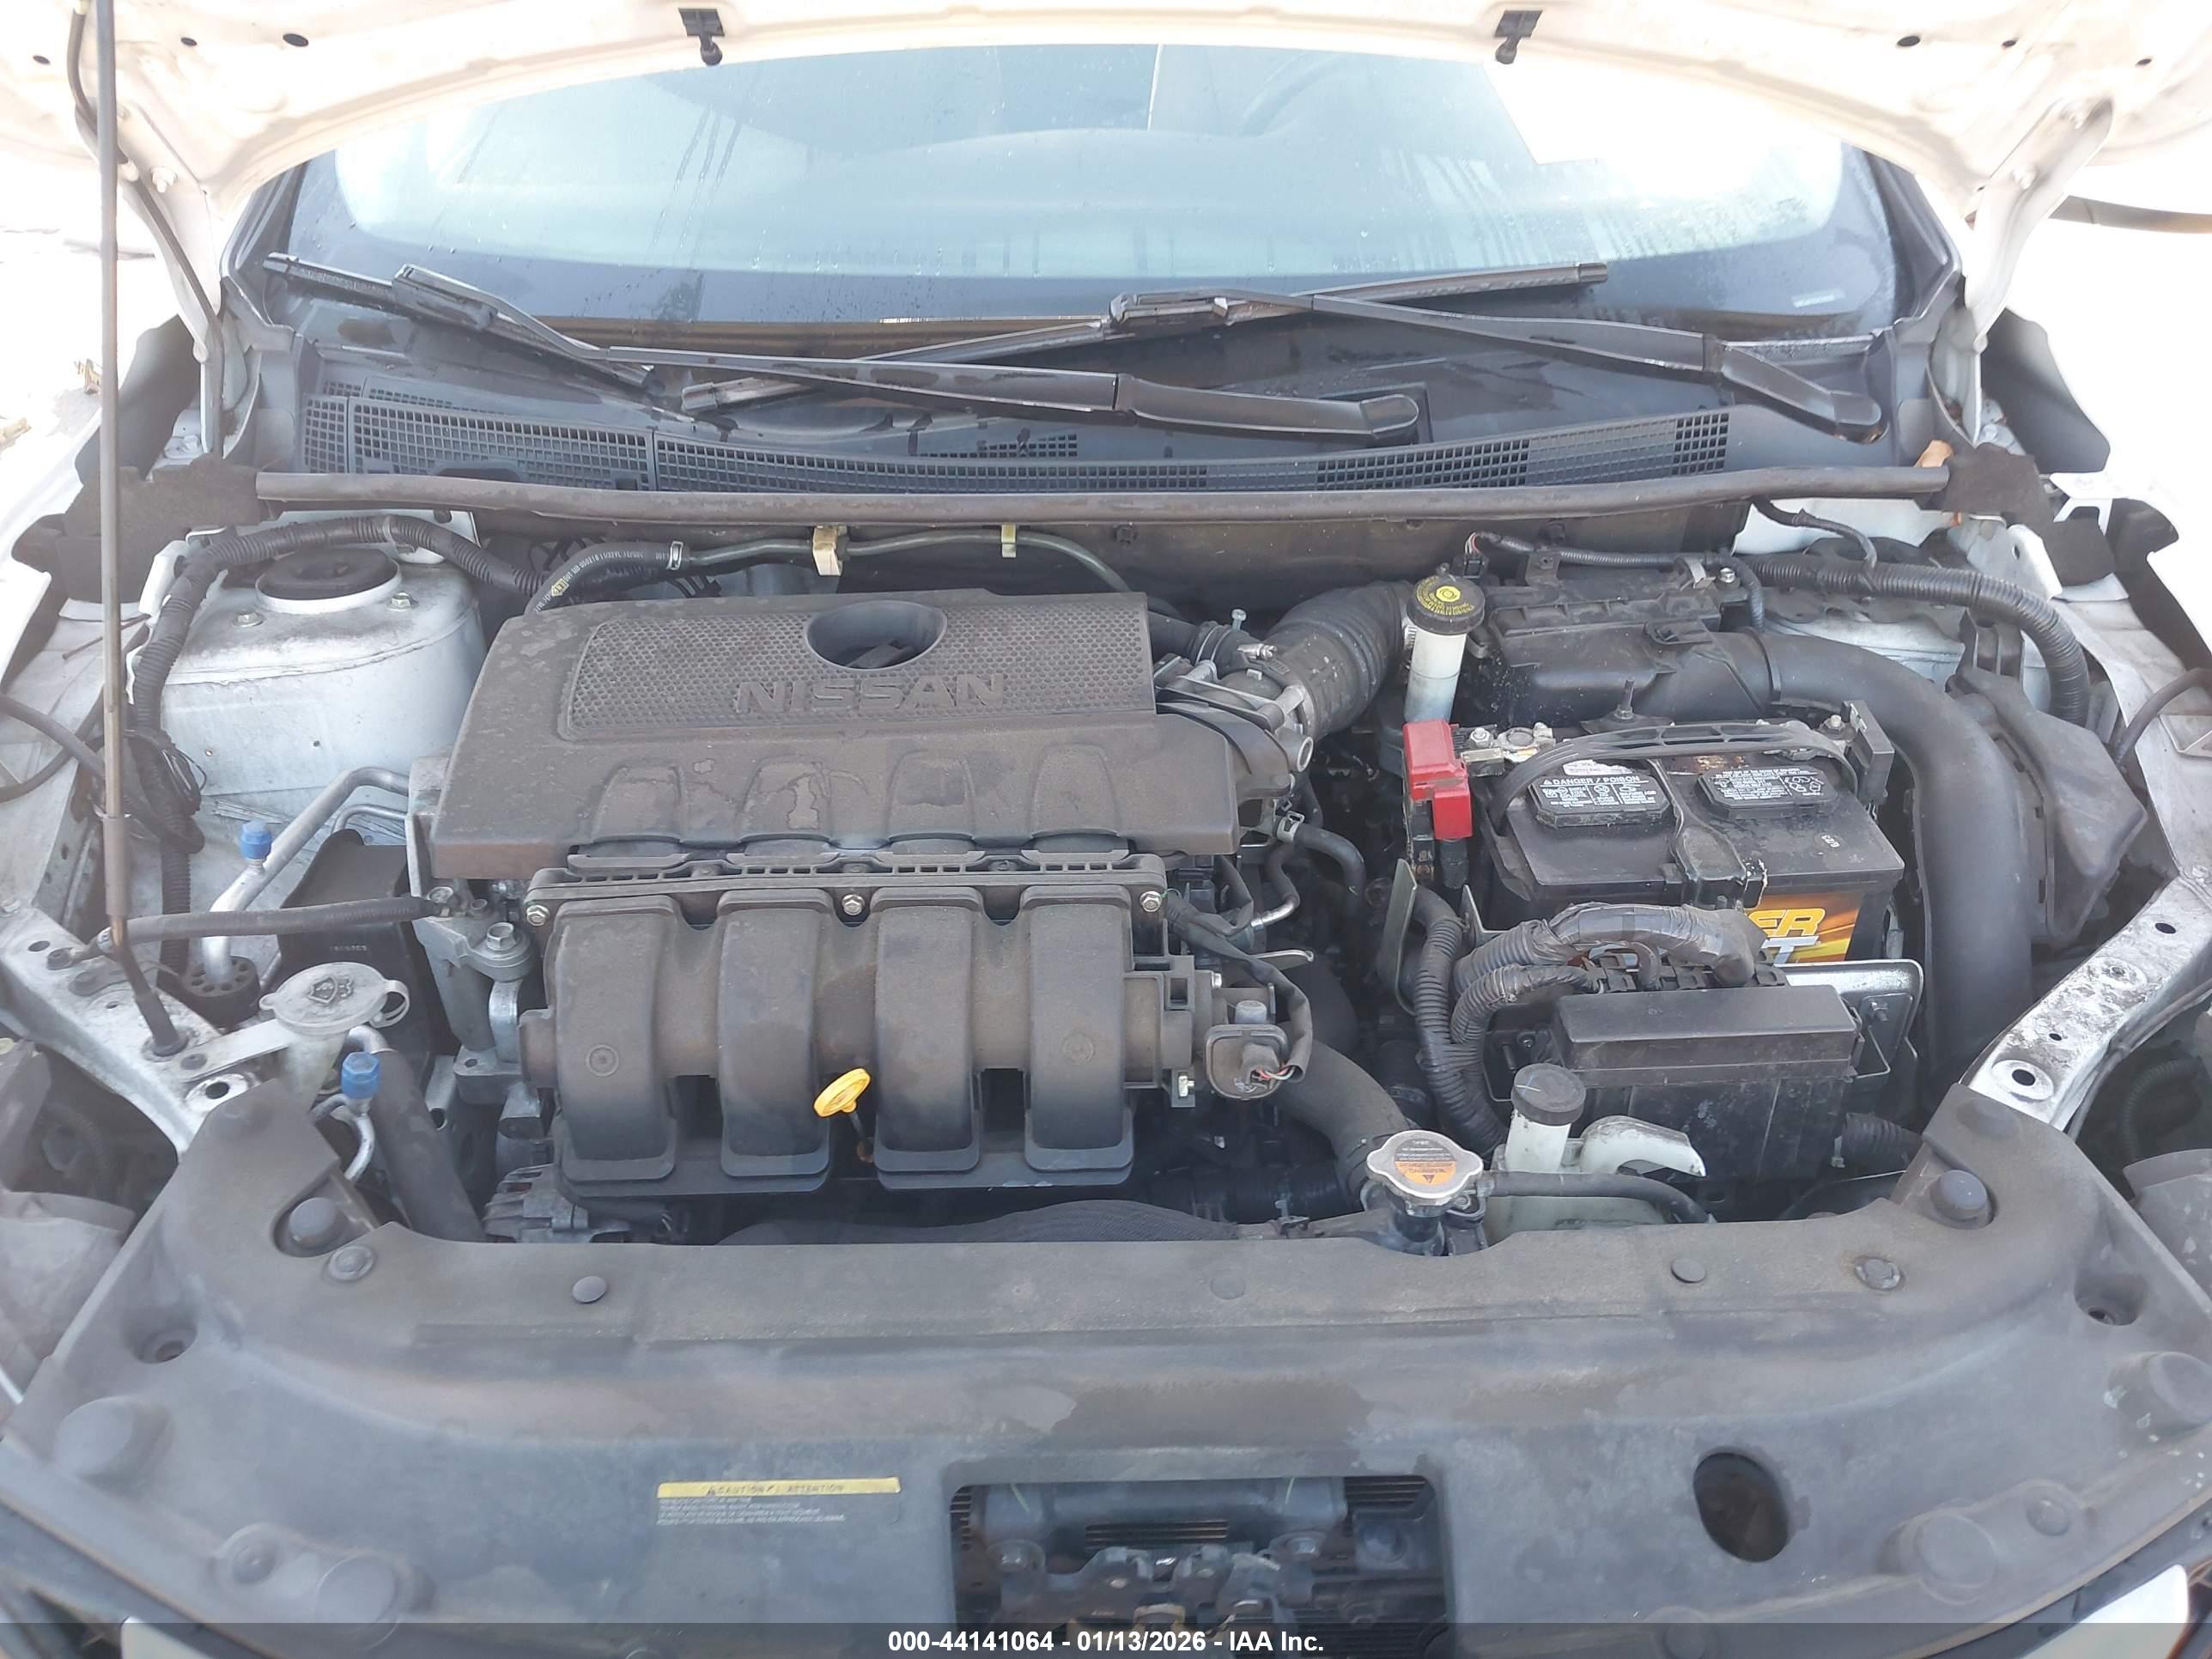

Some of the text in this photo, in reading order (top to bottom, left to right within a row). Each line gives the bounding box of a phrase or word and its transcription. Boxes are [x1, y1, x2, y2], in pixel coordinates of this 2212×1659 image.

[736, 672, 1005, 714] NISSAN
[720, 1484, 845, 1493] CAUTION ATTENTION
